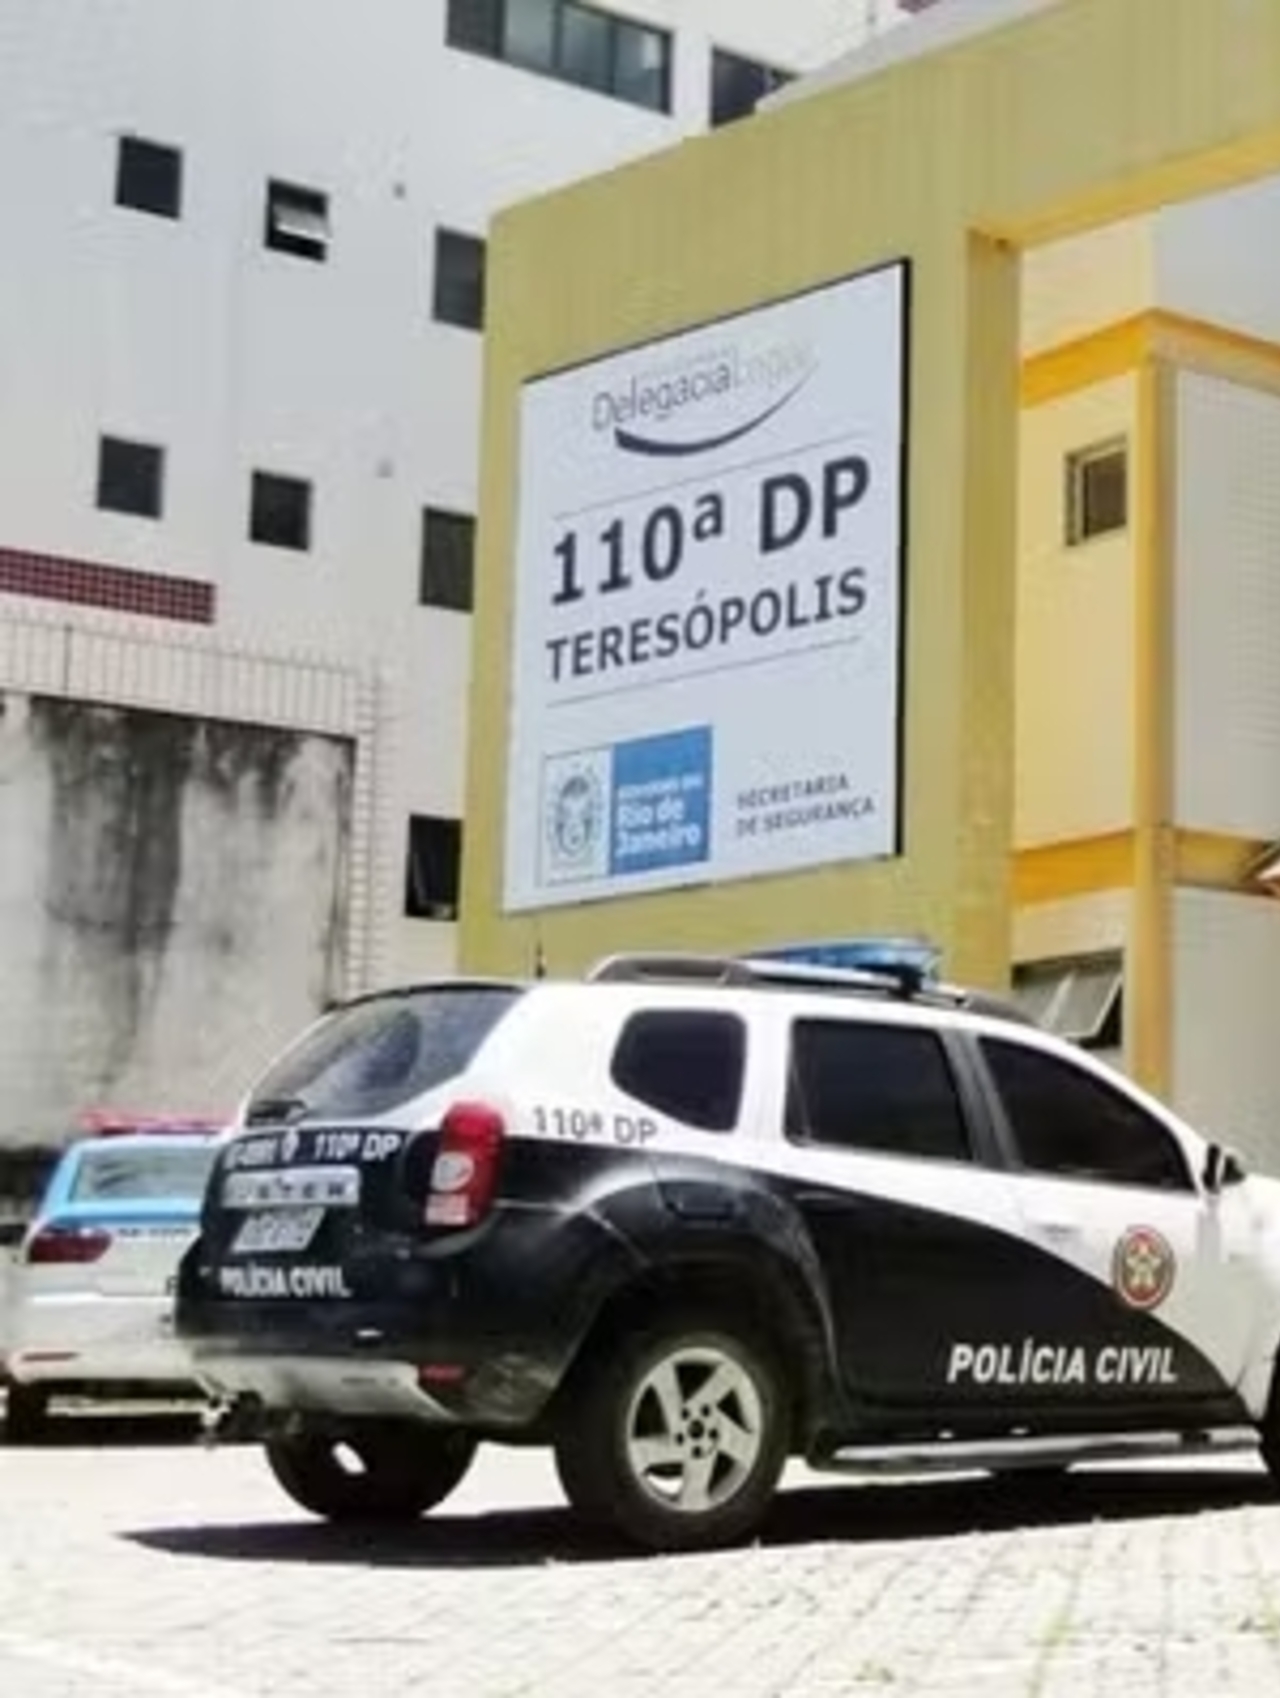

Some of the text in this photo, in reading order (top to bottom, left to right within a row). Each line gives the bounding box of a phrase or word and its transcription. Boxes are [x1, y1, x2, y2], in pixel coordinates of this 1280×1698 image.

[551, 455, 870, 606] 110ª DP
[546, 567, 867, 682] TERESÓPOLIS
[736, 773, 849, 811] SECRETARIA
[617, 795, 685, 829] Rio de
[736, 795, 876, 837] DE SEGURANÇA
[615, 822, 702, 858] Janeiro
[362, 1131, 401, 1162] DP
[614, 1114, 659, 1144] DP
[219, 1259, 289, 1298] POLÍCIA
[289, 1265, 353, 1298] CIVIL
[946, 1336, 1178, 1384] POLÍCIA CIVIL
